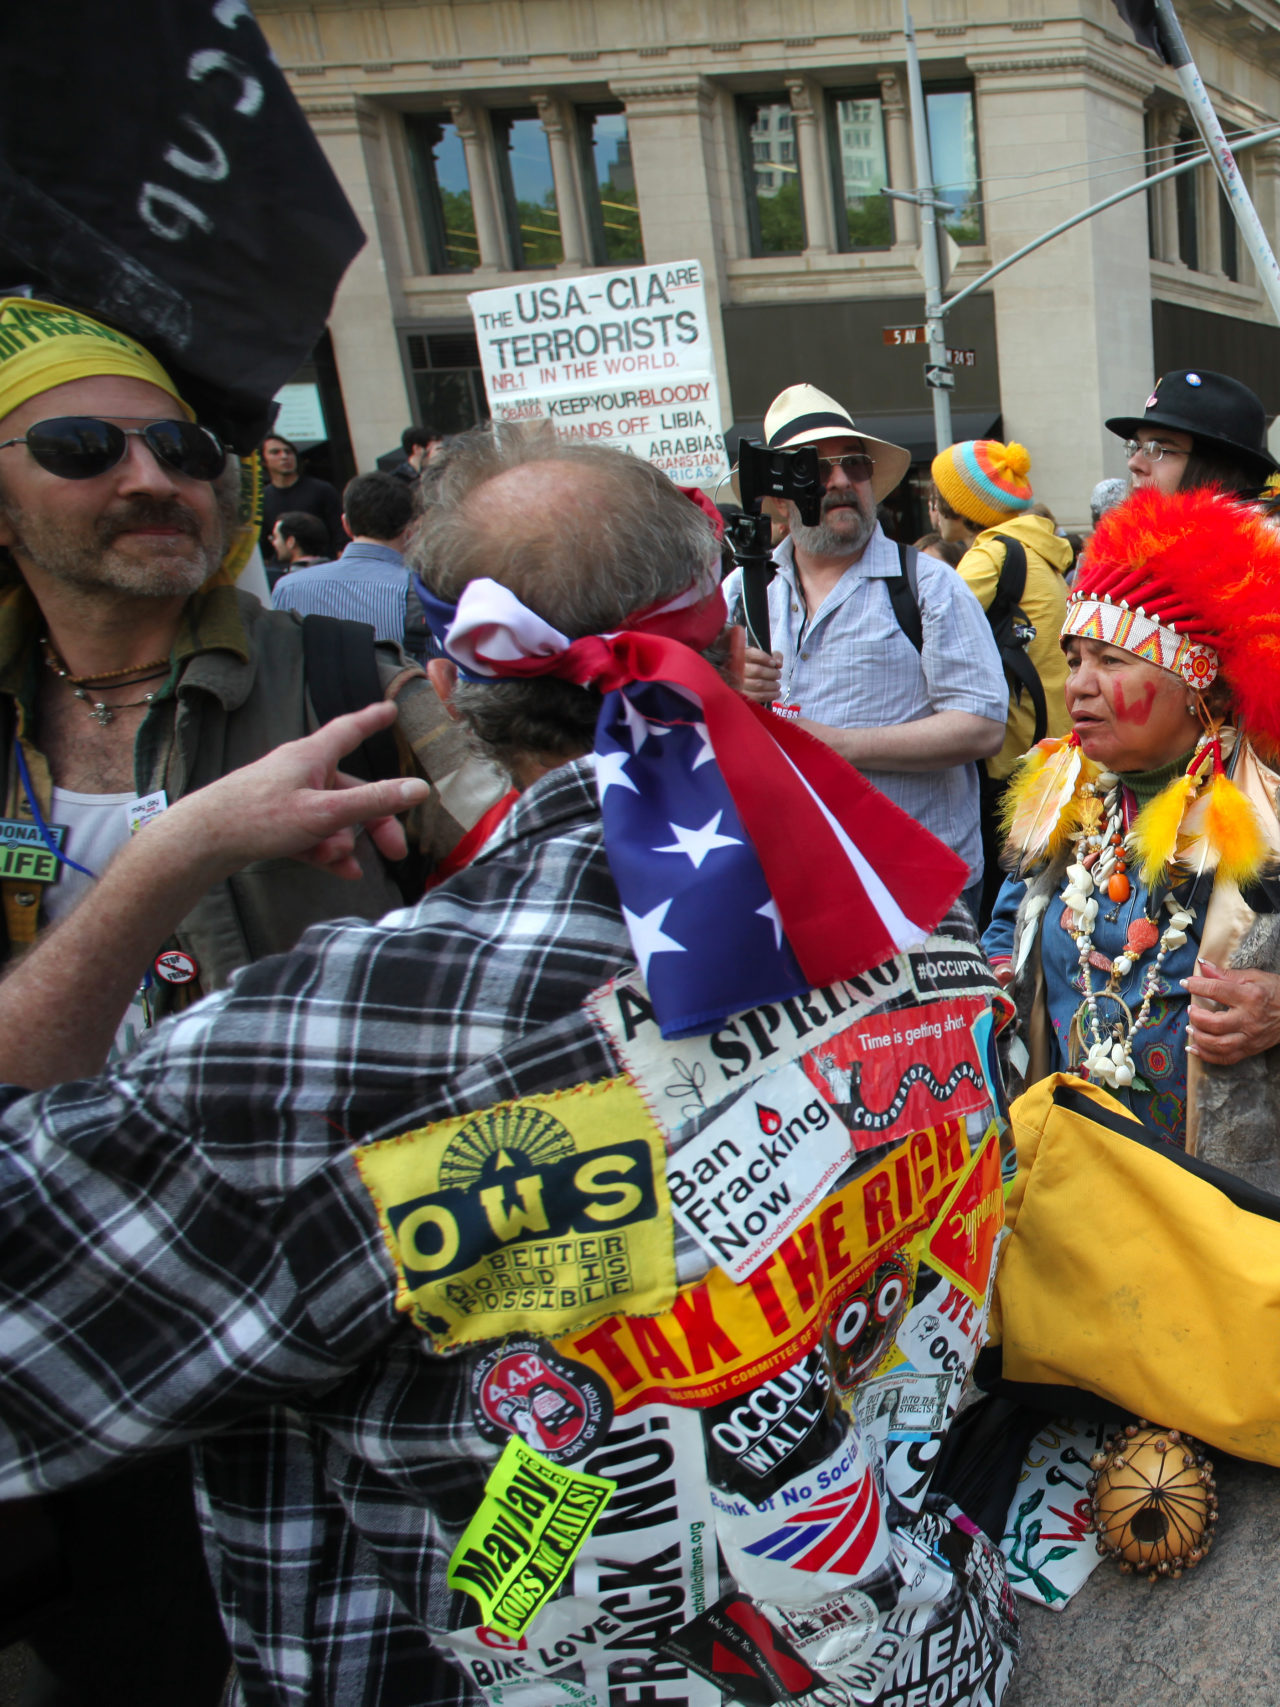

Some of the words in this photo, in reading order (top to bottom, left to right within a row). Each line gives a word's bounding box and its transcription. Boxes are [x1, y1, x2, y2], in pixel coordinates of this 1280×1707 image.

[480, 311, 513, 331] THE
[665, 266, 699, 287] ARE
[490, 310, 699, 369] TERRORISTS
[893, 330, 902, 345] 5
[904, 329, 917, 344] AV
[492, 371, 526, 391] NR.1
[540, 365, 557, 384] IN
[563, 360, 598, 381] THE
[605, 352, 680, 375] WORLD.
[501, 405, 544, 421] OBAMA
[557, 419, 613, 441] HANDS
[617, 415, 650, 436] OFF
[0, 851, 54, 877] IFE
[858, 1032, 892, 1051] Time
[892, 1027, 903, 1044] is
[905, 1020, 942, 1046] getting
[667, 1138, 742, 1208] Ban
[684, 1098, 831, 1236] Fracking
[397, 1154, 643, 1273] OWS
[708, 1181, 793, 1262] Now
[488, 1236, 623, 1270] BETTER
[573, 1284, 741, 1393] TAX
[743, 1200, 851, 1340] THE
[862, 1117, 966, 1249] RICH
[582, 1257, 626, 1282] IS
[488, 1355, 545, 1402] 4.4.12
[730, 1341, 799, 1388] COMMITTEE
[801, 1329, 814, 1345] OF
[580, 1382, 603, 1422] ACTION
[563, 1439, 587, 1457] DAY
[583, 1424, 598, 1439] OF
[741, 1404, 821, 1473] WALL
[514, 1449, 569, 1487] 2012
[584, 1416, 680, 1538] NO!
[710, 1490, 750, 1516] Bank
[780, 1485, 813, 1507] No
[494, 1568, 546, 1630] JOBS
[546, 1482, 606, 1551] JAILS!
[471, 1656, 537, 1687] BIKE
[538, 1615, 621, 1667] LOVE
